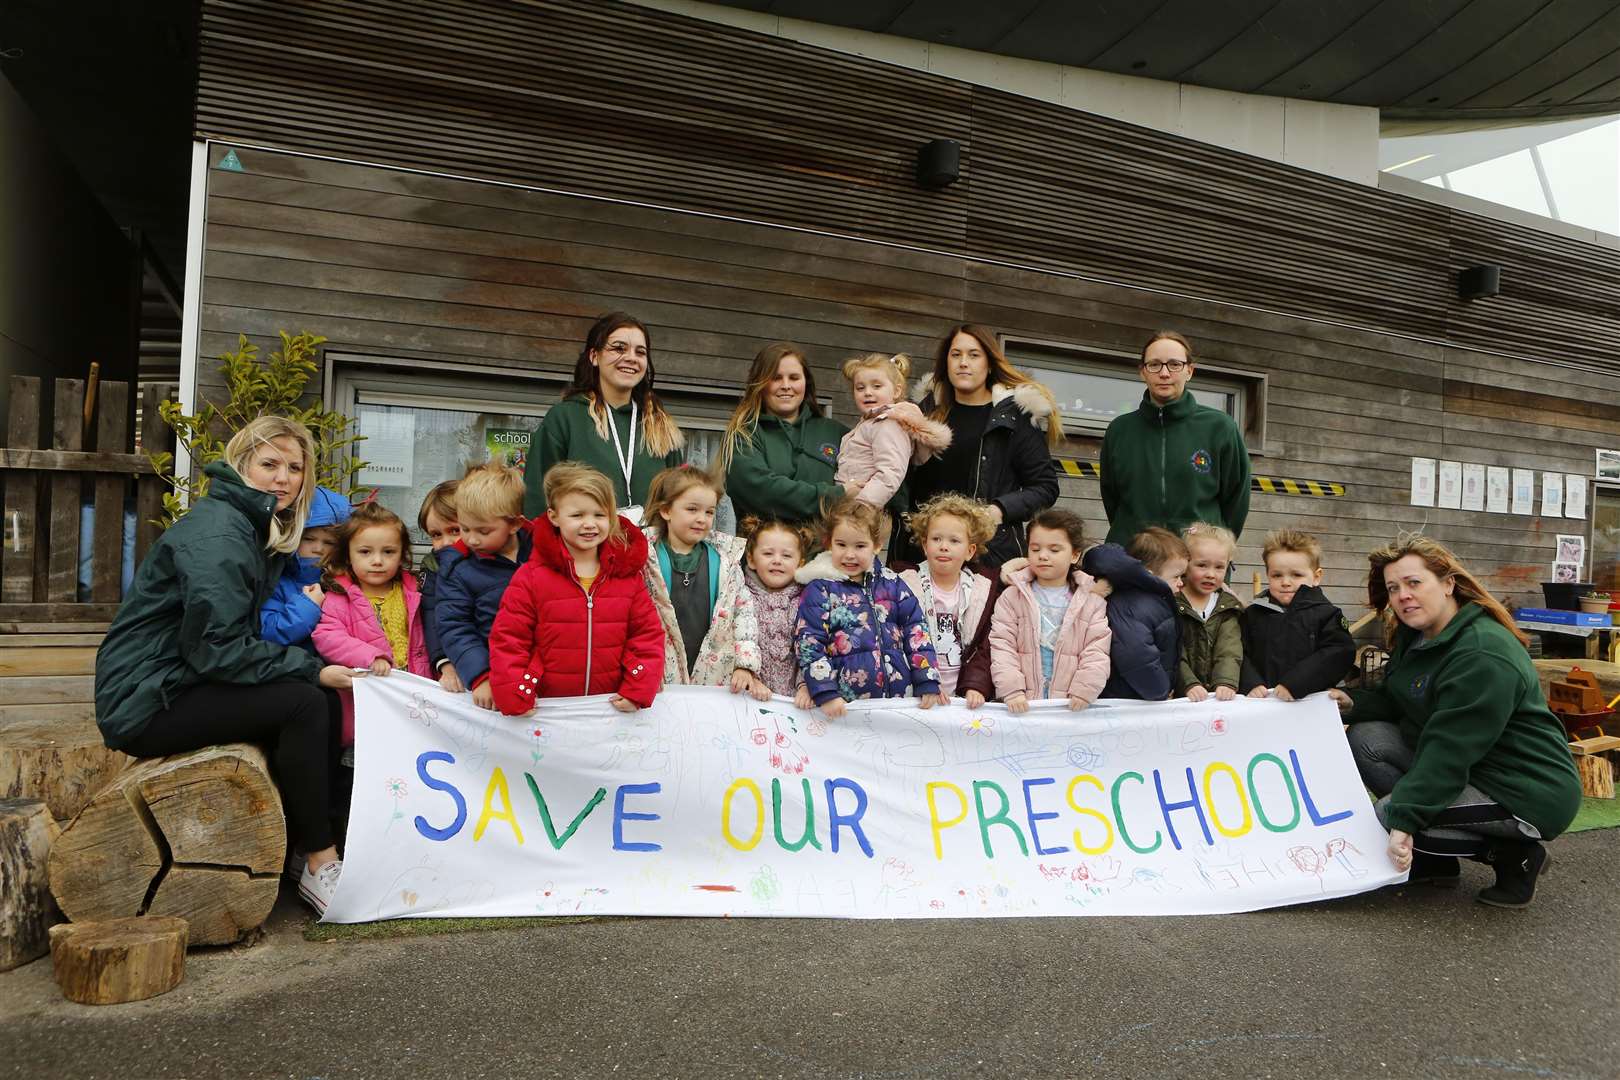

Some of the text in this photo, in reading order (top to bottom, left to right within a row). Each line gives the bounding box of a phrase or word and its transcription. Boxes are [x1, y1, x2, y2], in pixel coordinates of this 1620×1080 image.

[494, 432, 531, 444] school
[414, 749, 1353, 860] SAVE OUR PRESCHOOL
